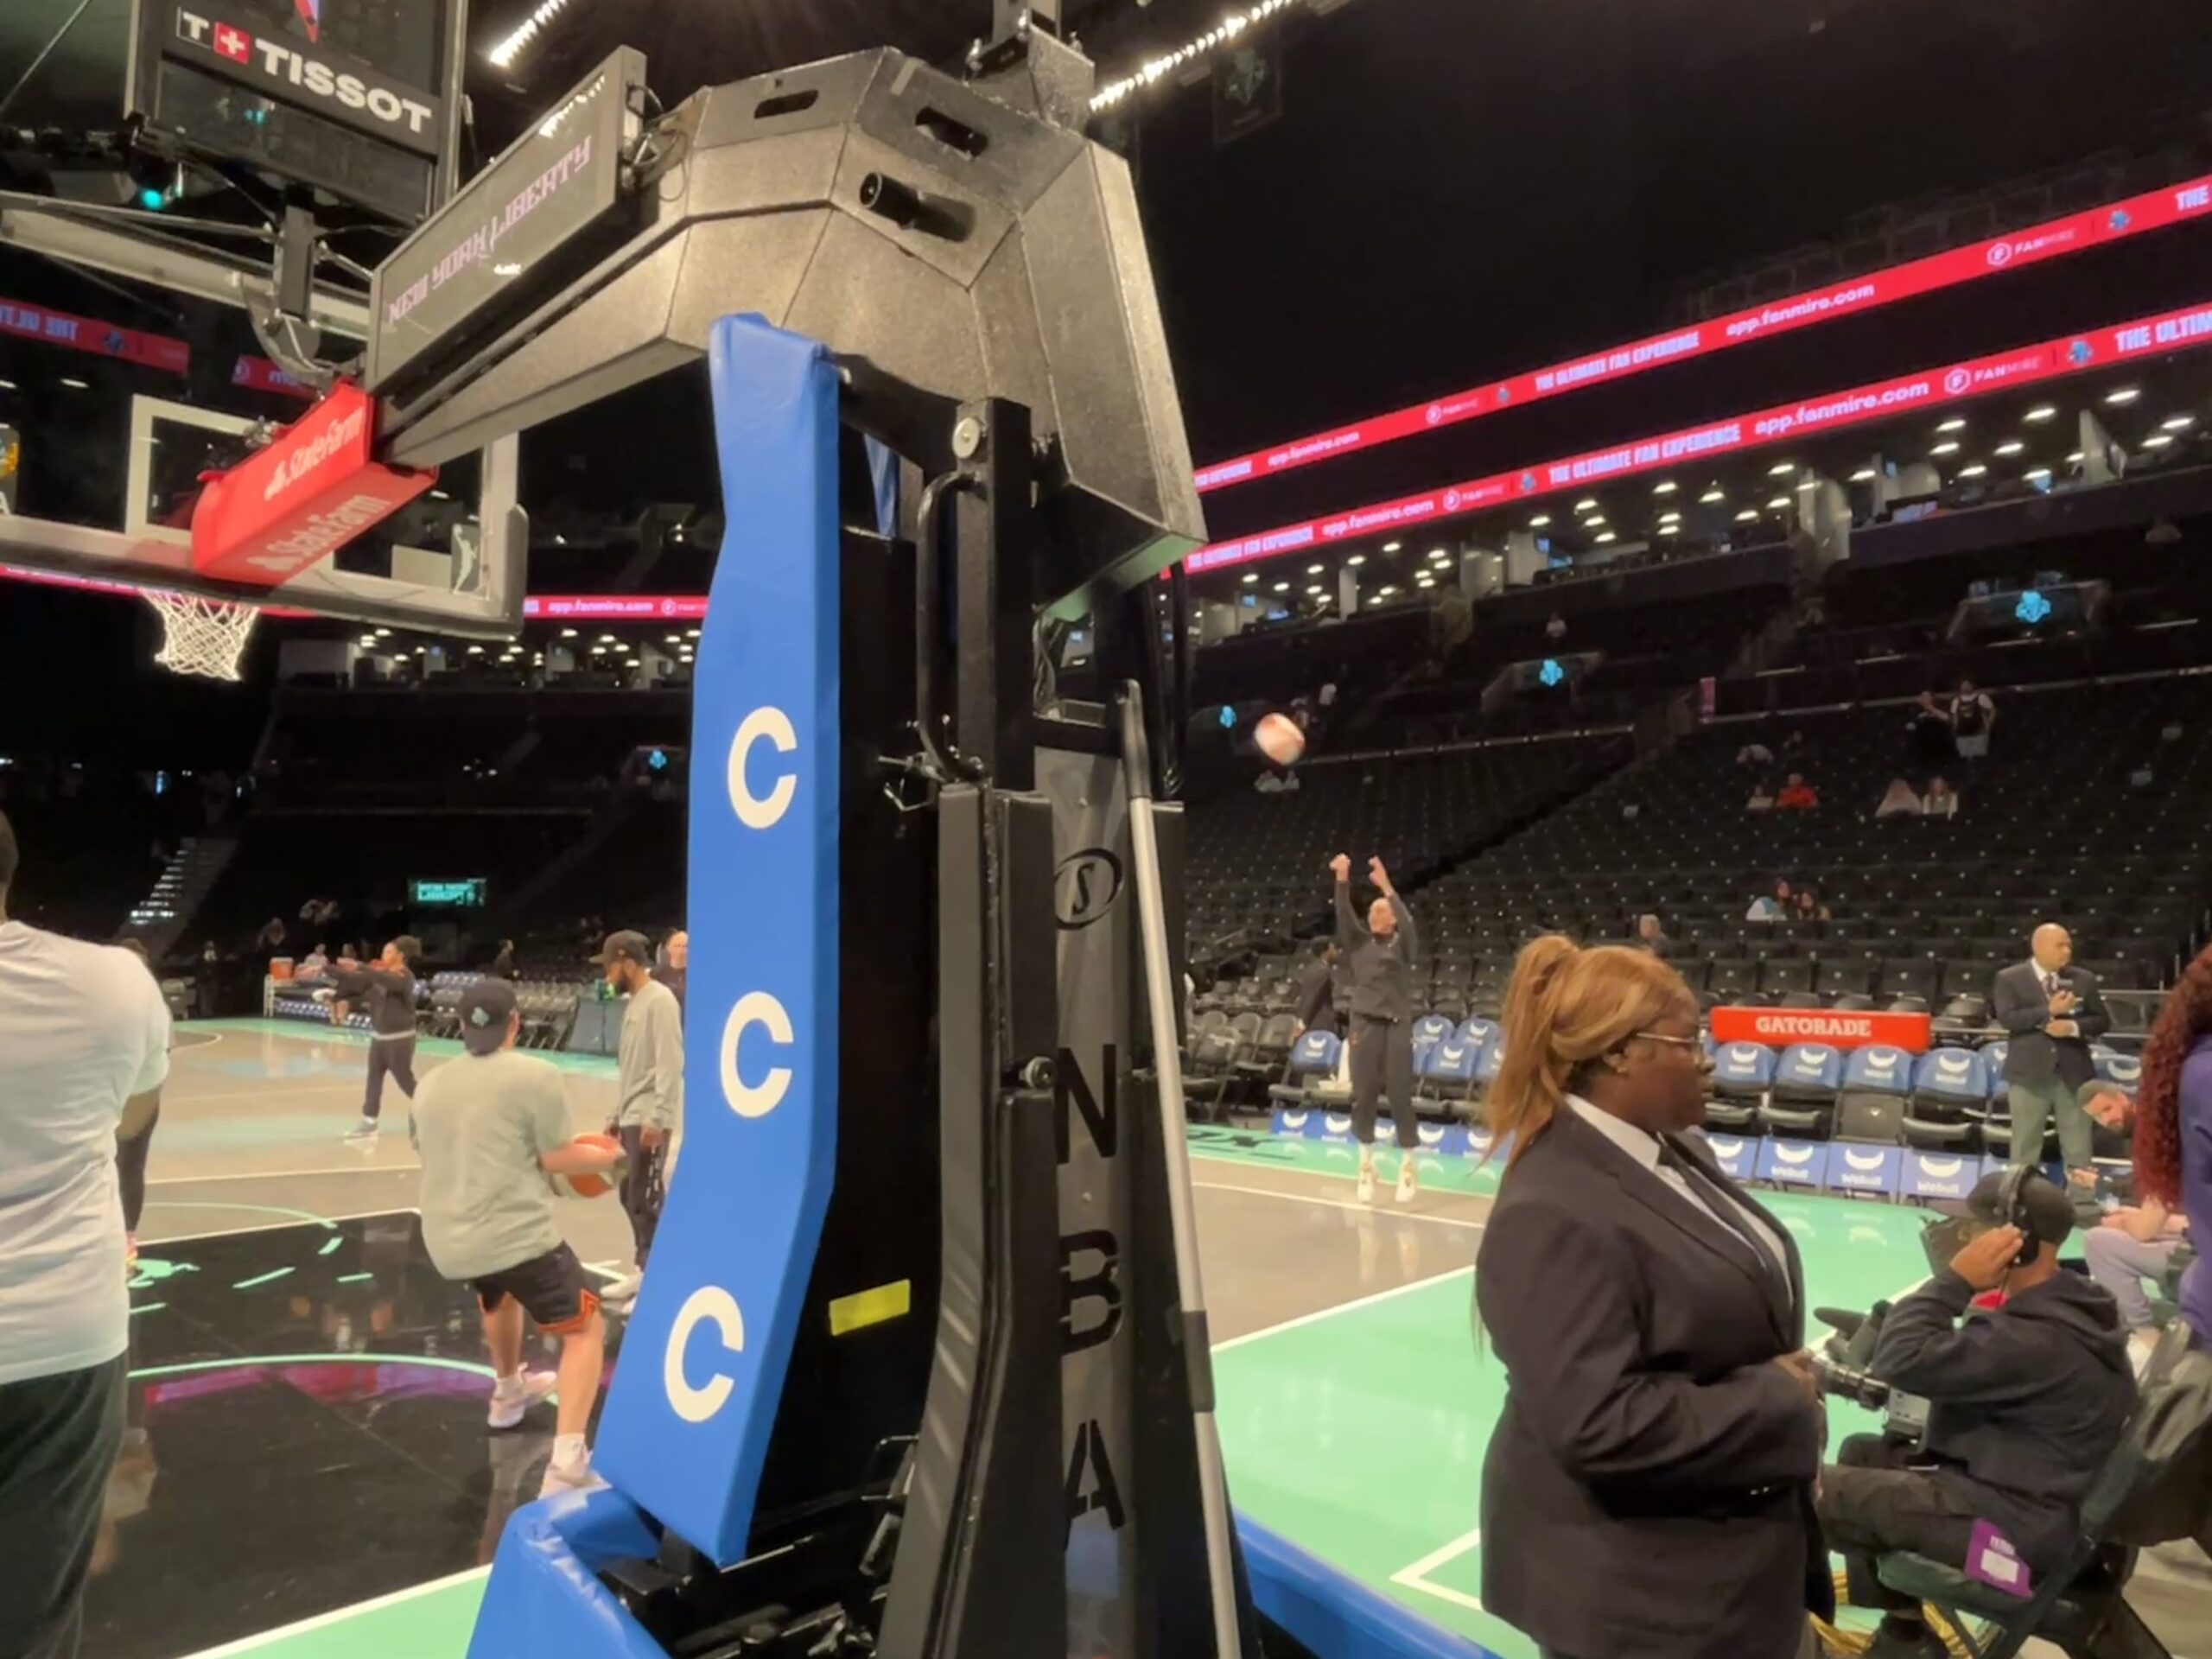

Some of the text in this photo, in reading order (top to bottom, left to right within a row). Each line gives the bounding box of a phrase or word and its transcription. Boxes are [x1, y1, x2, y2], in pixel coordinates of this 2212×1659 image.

[255, 37, 431, 133] TISSOT
[2175, 184, 2210, 211] THE
[1726, 283, 1874, 335] app.fanmire.com
[2115, 325, 2152, 353] THE
[1548, 465, 1570, 485] THE
[1634, 442, 1660, 465] FAN
[1662, 423, 1741, 460] EXPERIENCE
[1755, 381, 1929, 435] app.fanmire.com
[1755, 1015, 1872, 1038] GATORADE
